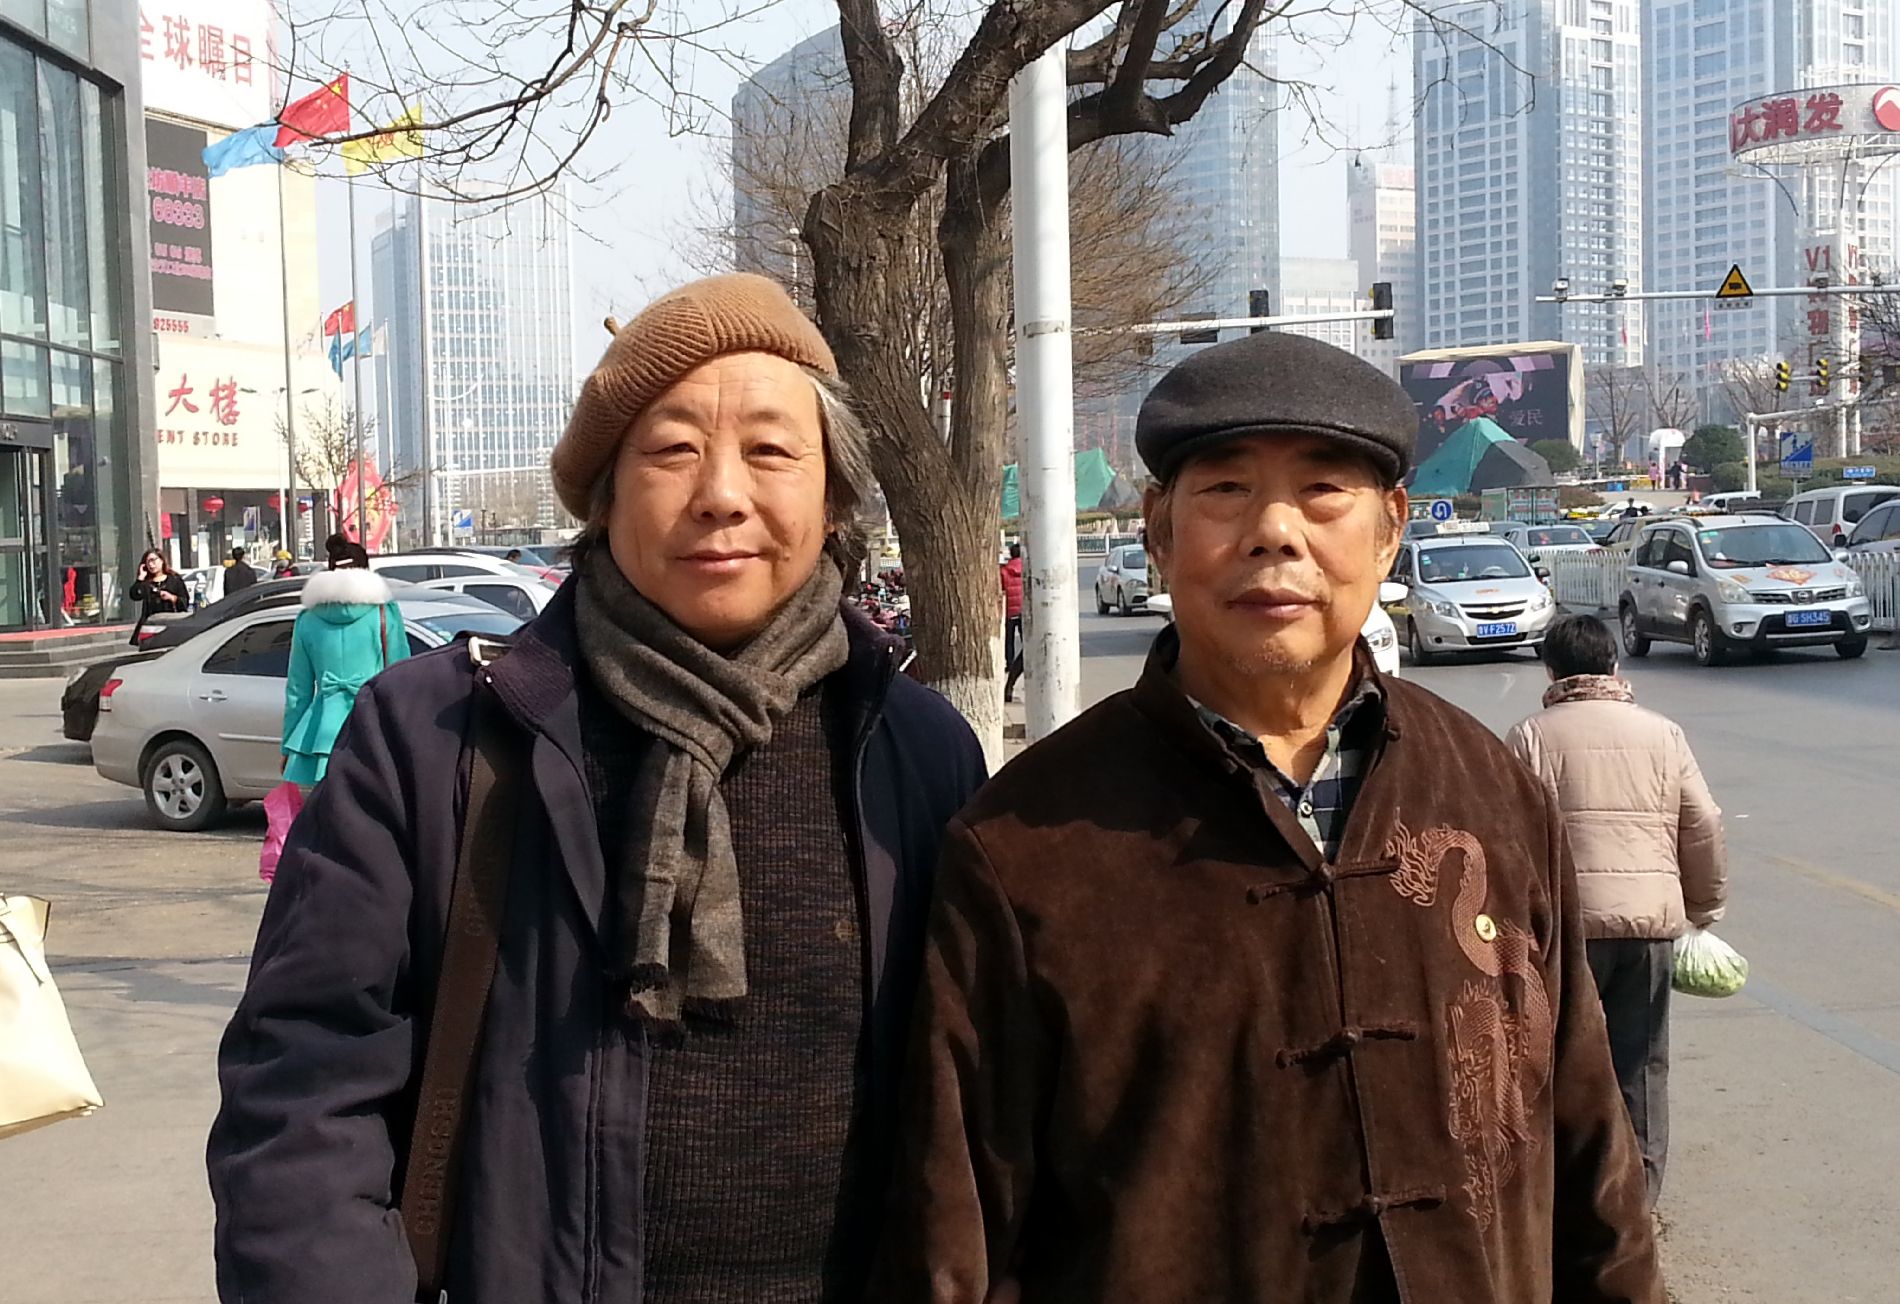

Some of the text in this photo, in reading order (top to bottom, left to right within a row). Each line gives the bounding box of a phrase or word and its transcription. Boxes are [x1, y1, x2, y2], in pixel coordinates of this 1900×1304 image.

[1734, 92, 1844, 148] 大润发
[193, 431, 238, 447] STORE
